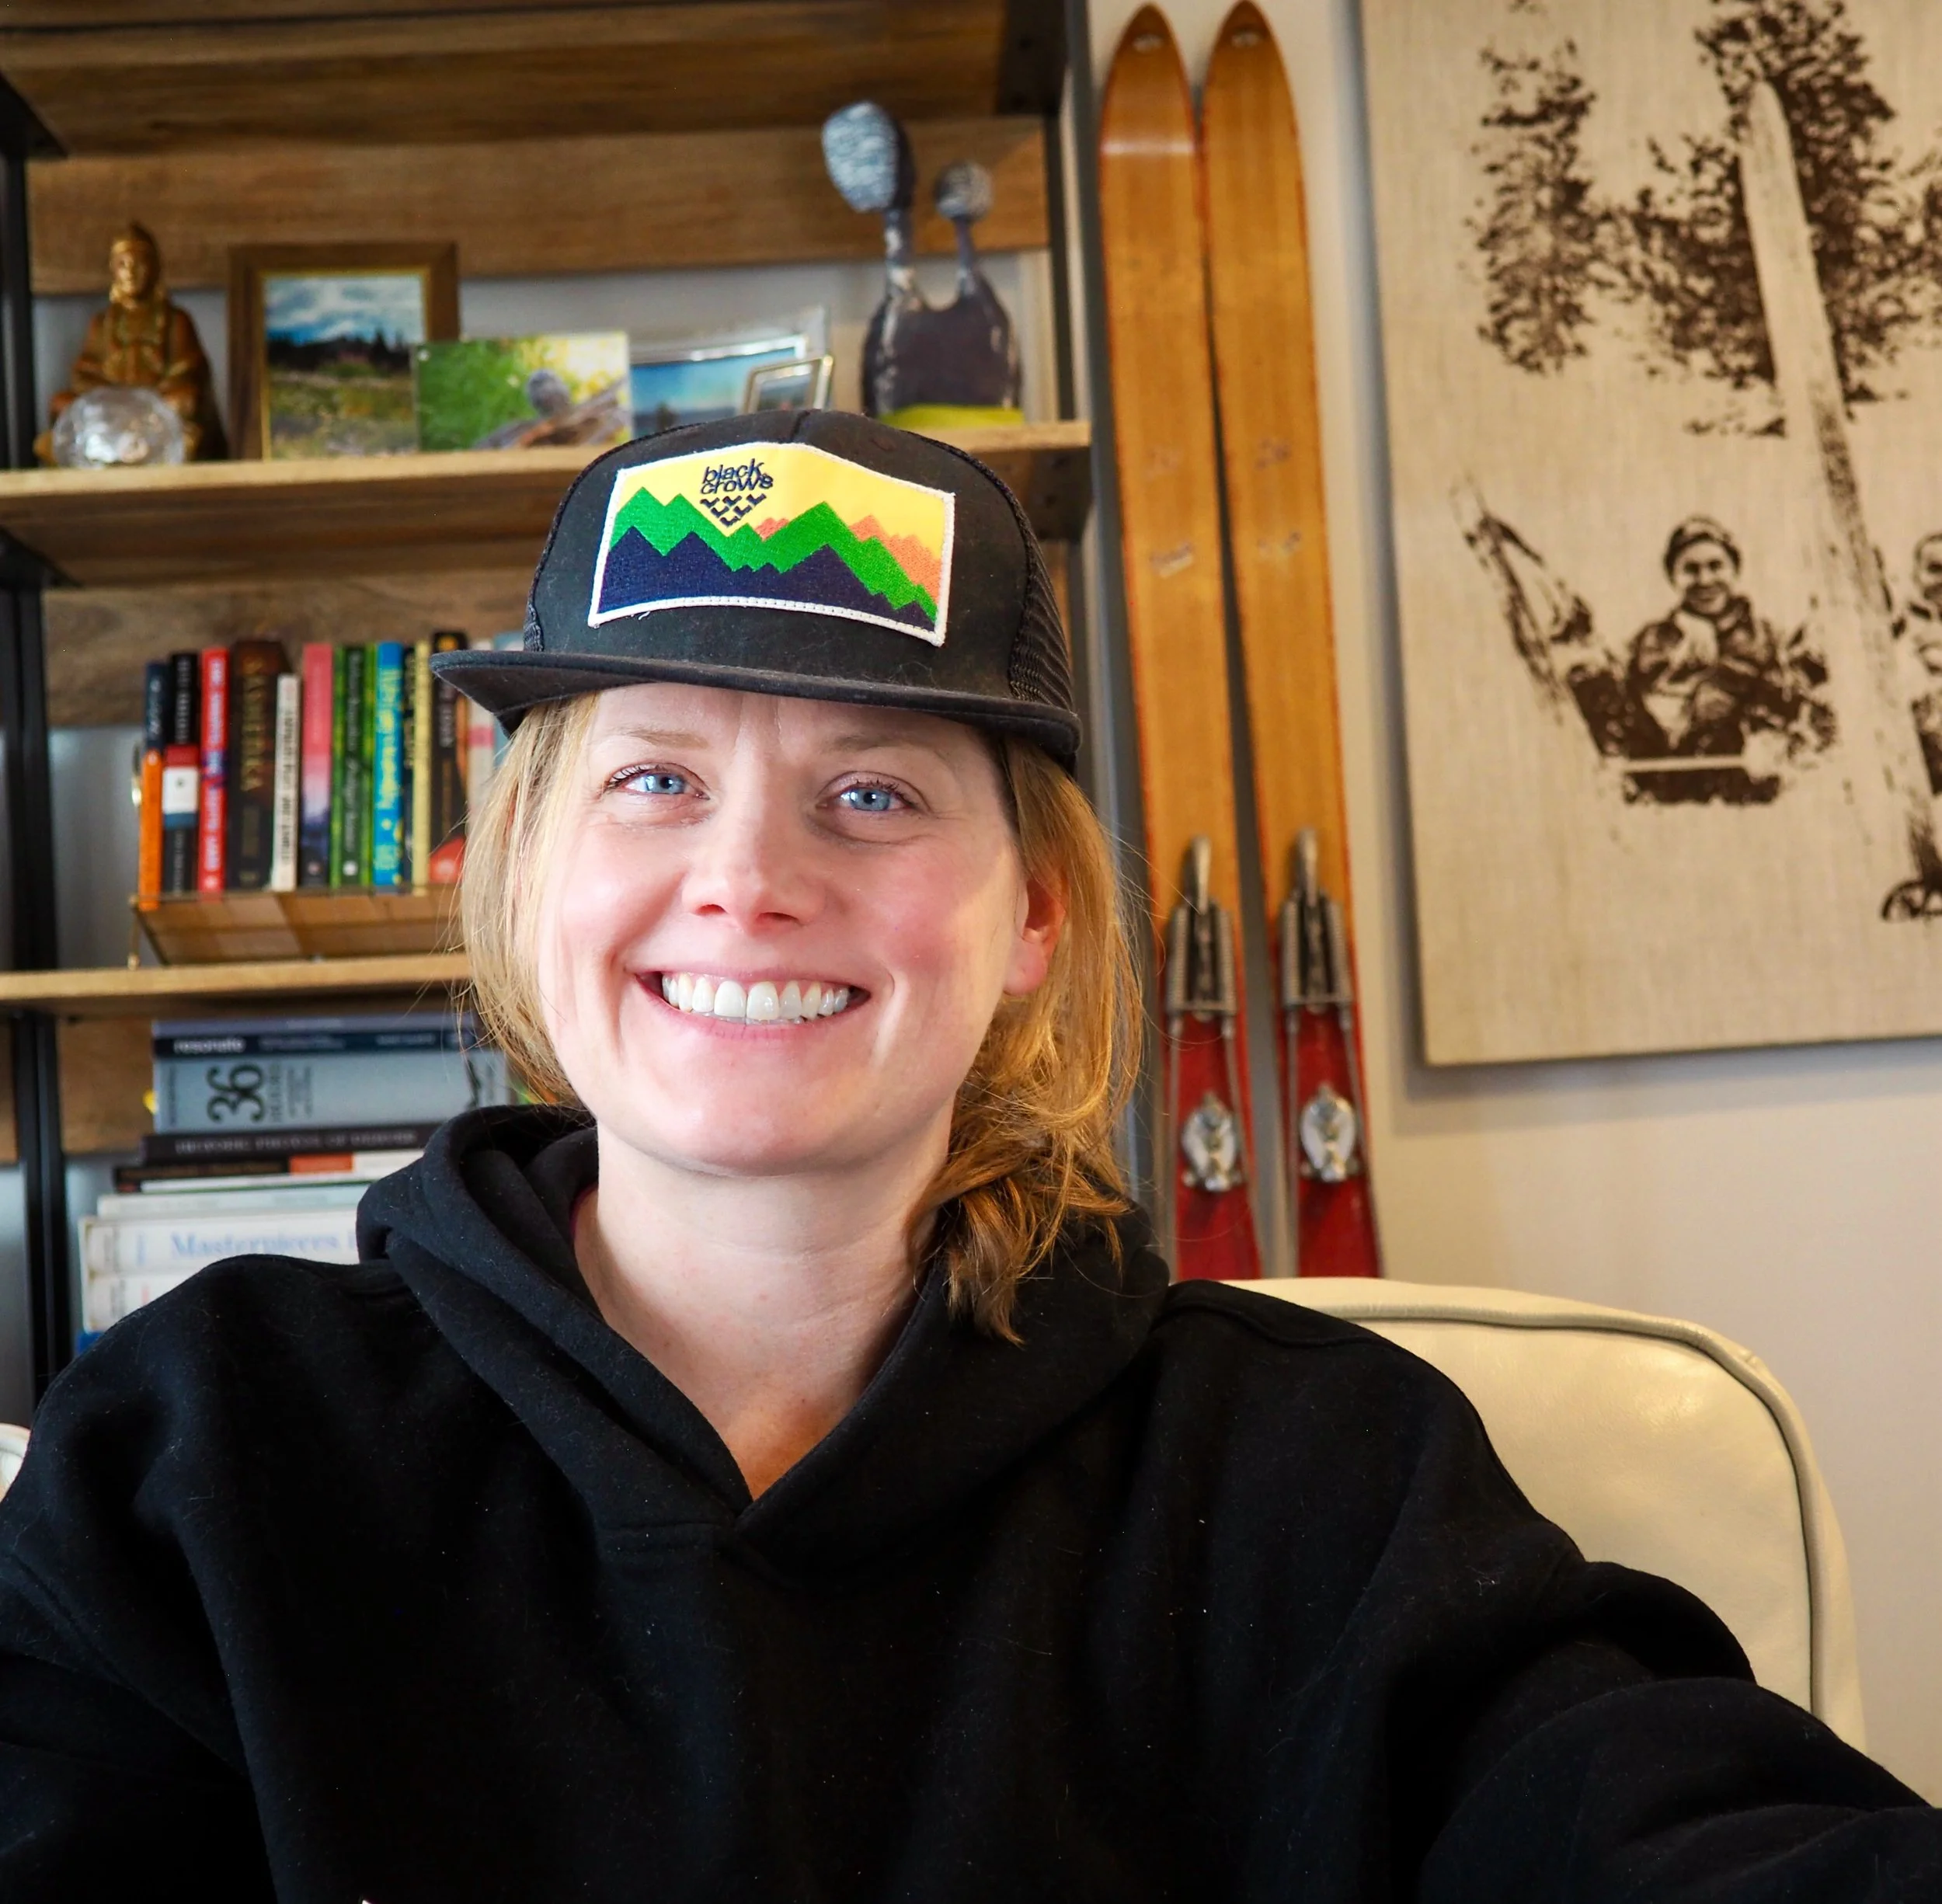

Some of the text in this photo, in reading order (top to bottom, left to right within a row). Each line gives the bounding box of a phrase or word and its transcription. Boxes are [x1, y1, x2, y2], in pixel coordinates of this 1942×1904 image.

[702, 458, 765, 485] black
[701, 474, 774, 495] crows
[172, 1036, 247, 1055] resonate
[205, 1061, 266, 1123] 36
